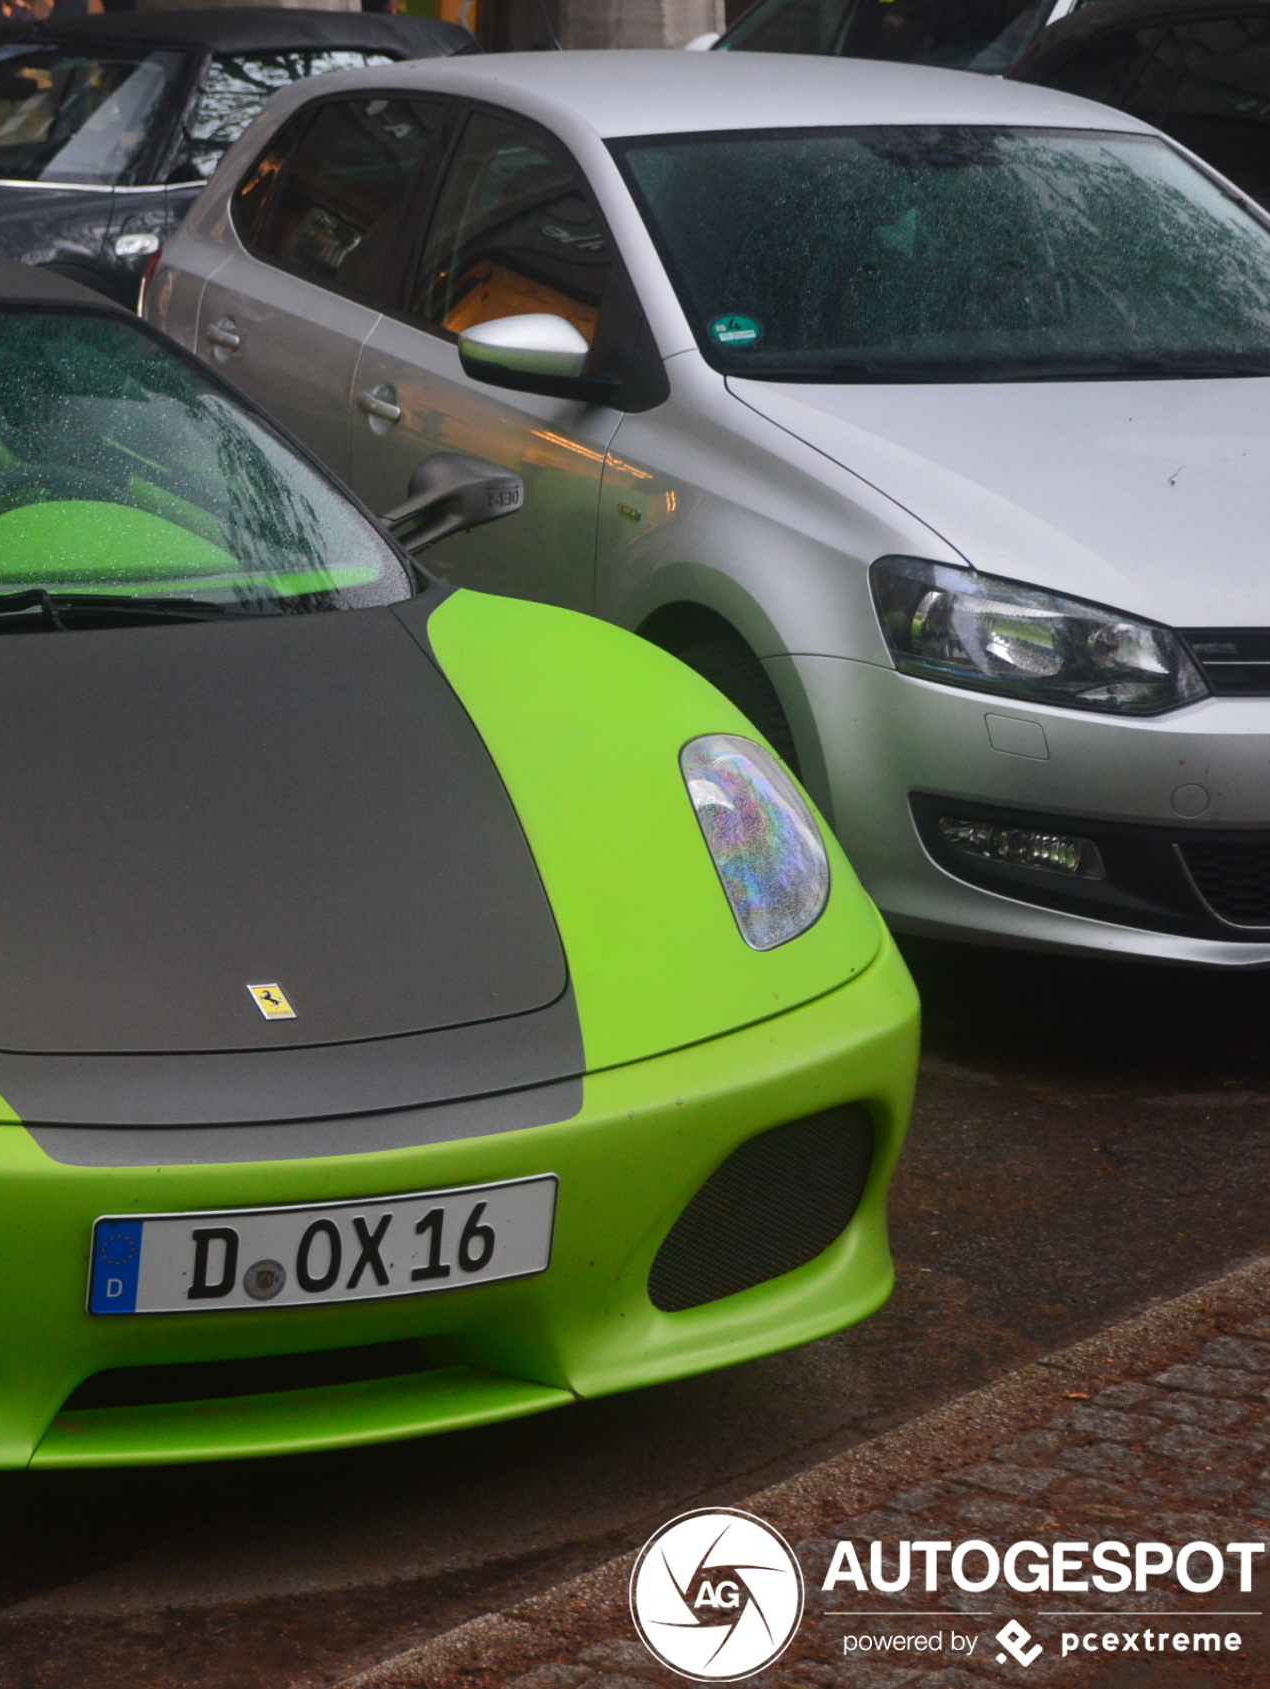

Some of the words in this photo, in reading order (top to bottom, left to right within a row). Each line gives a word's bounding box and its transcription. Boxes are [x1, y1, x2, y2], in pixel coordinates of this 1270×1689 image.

[727, 317, 741, 330] 4
[187, 1227, 239, 1300] D
[296, 1213, 393, 1294] OX
[411, 1201, 496, 1282] 16
[106, 1279, 123, 1298] D
